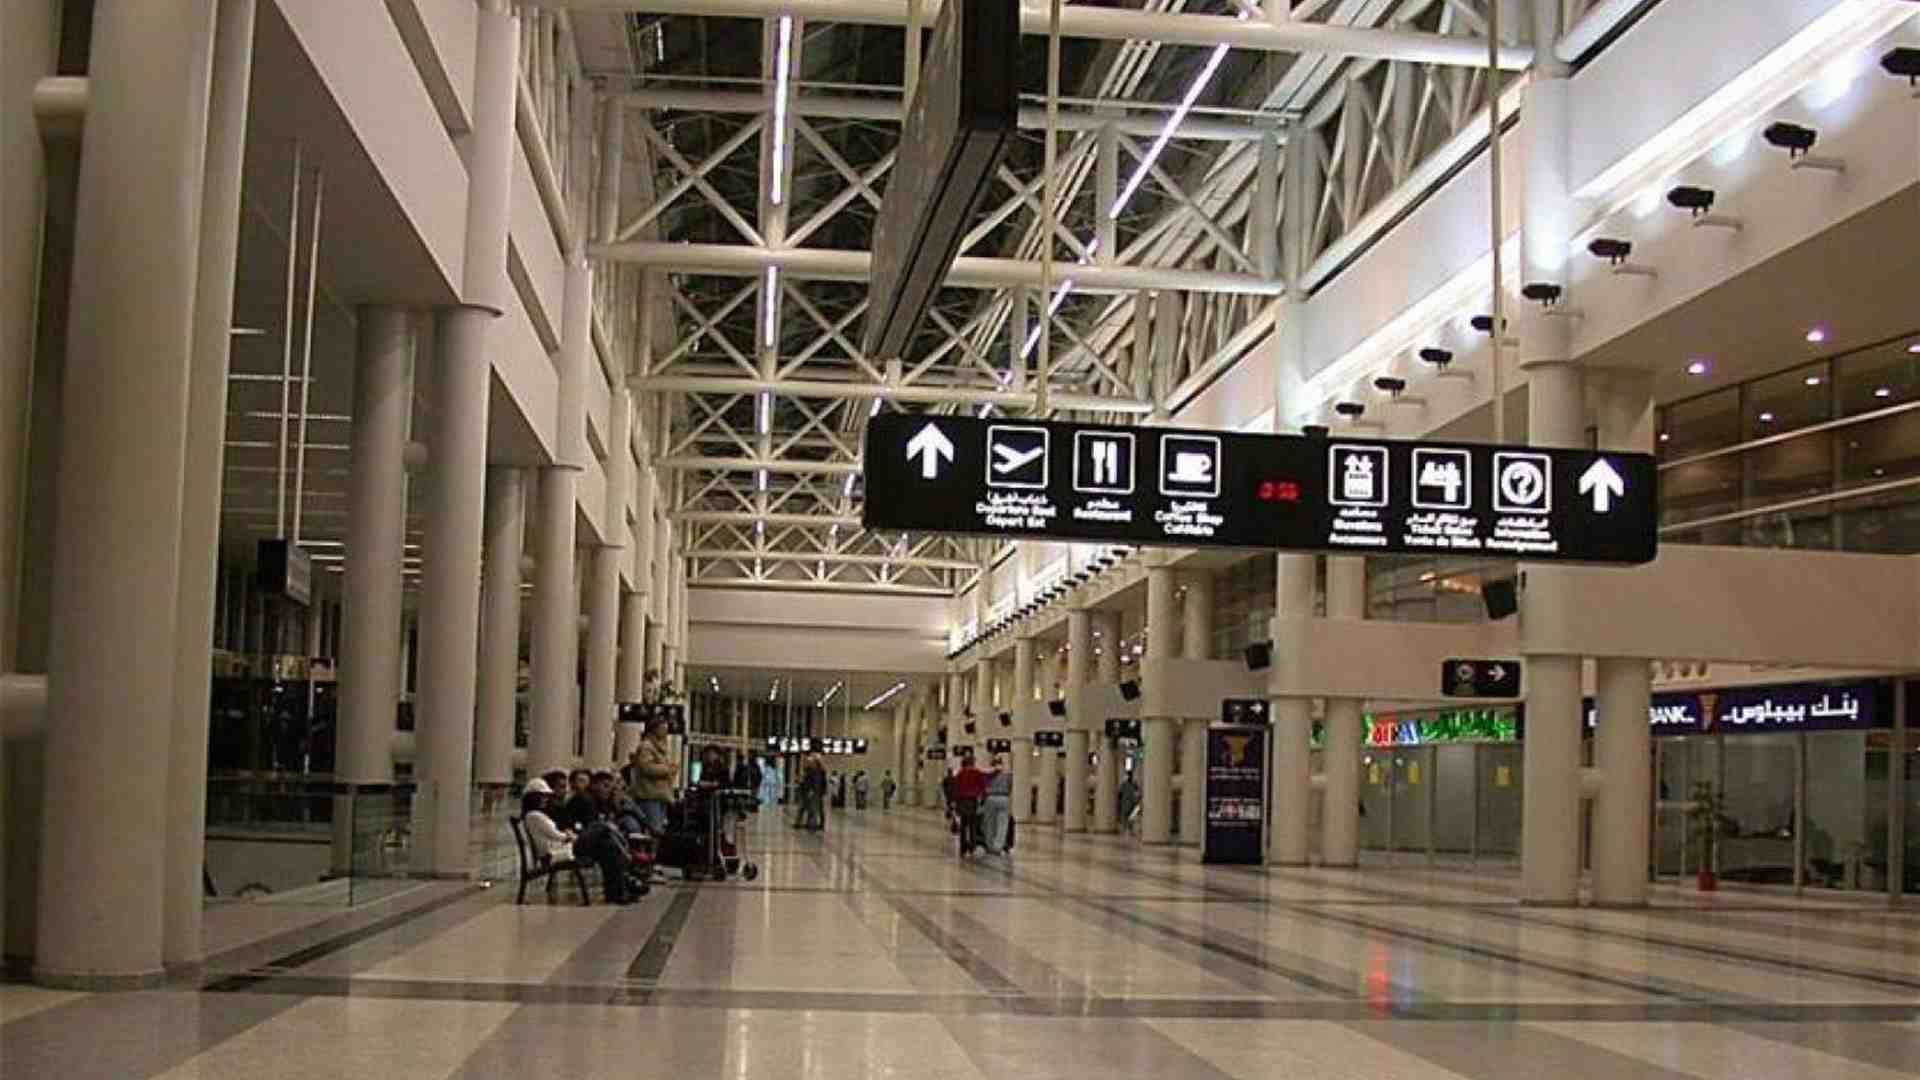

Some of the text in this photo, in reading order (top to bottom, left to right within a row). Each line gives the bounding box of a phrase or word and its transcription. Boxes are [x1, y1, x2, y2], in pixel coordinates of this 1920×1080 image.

[1073, 507, 1132, 522] Restaurant
[1155, 510, 1223, 526] Coffee Shop
[1730, 692, 1859, 724] بنك بيبلوس
